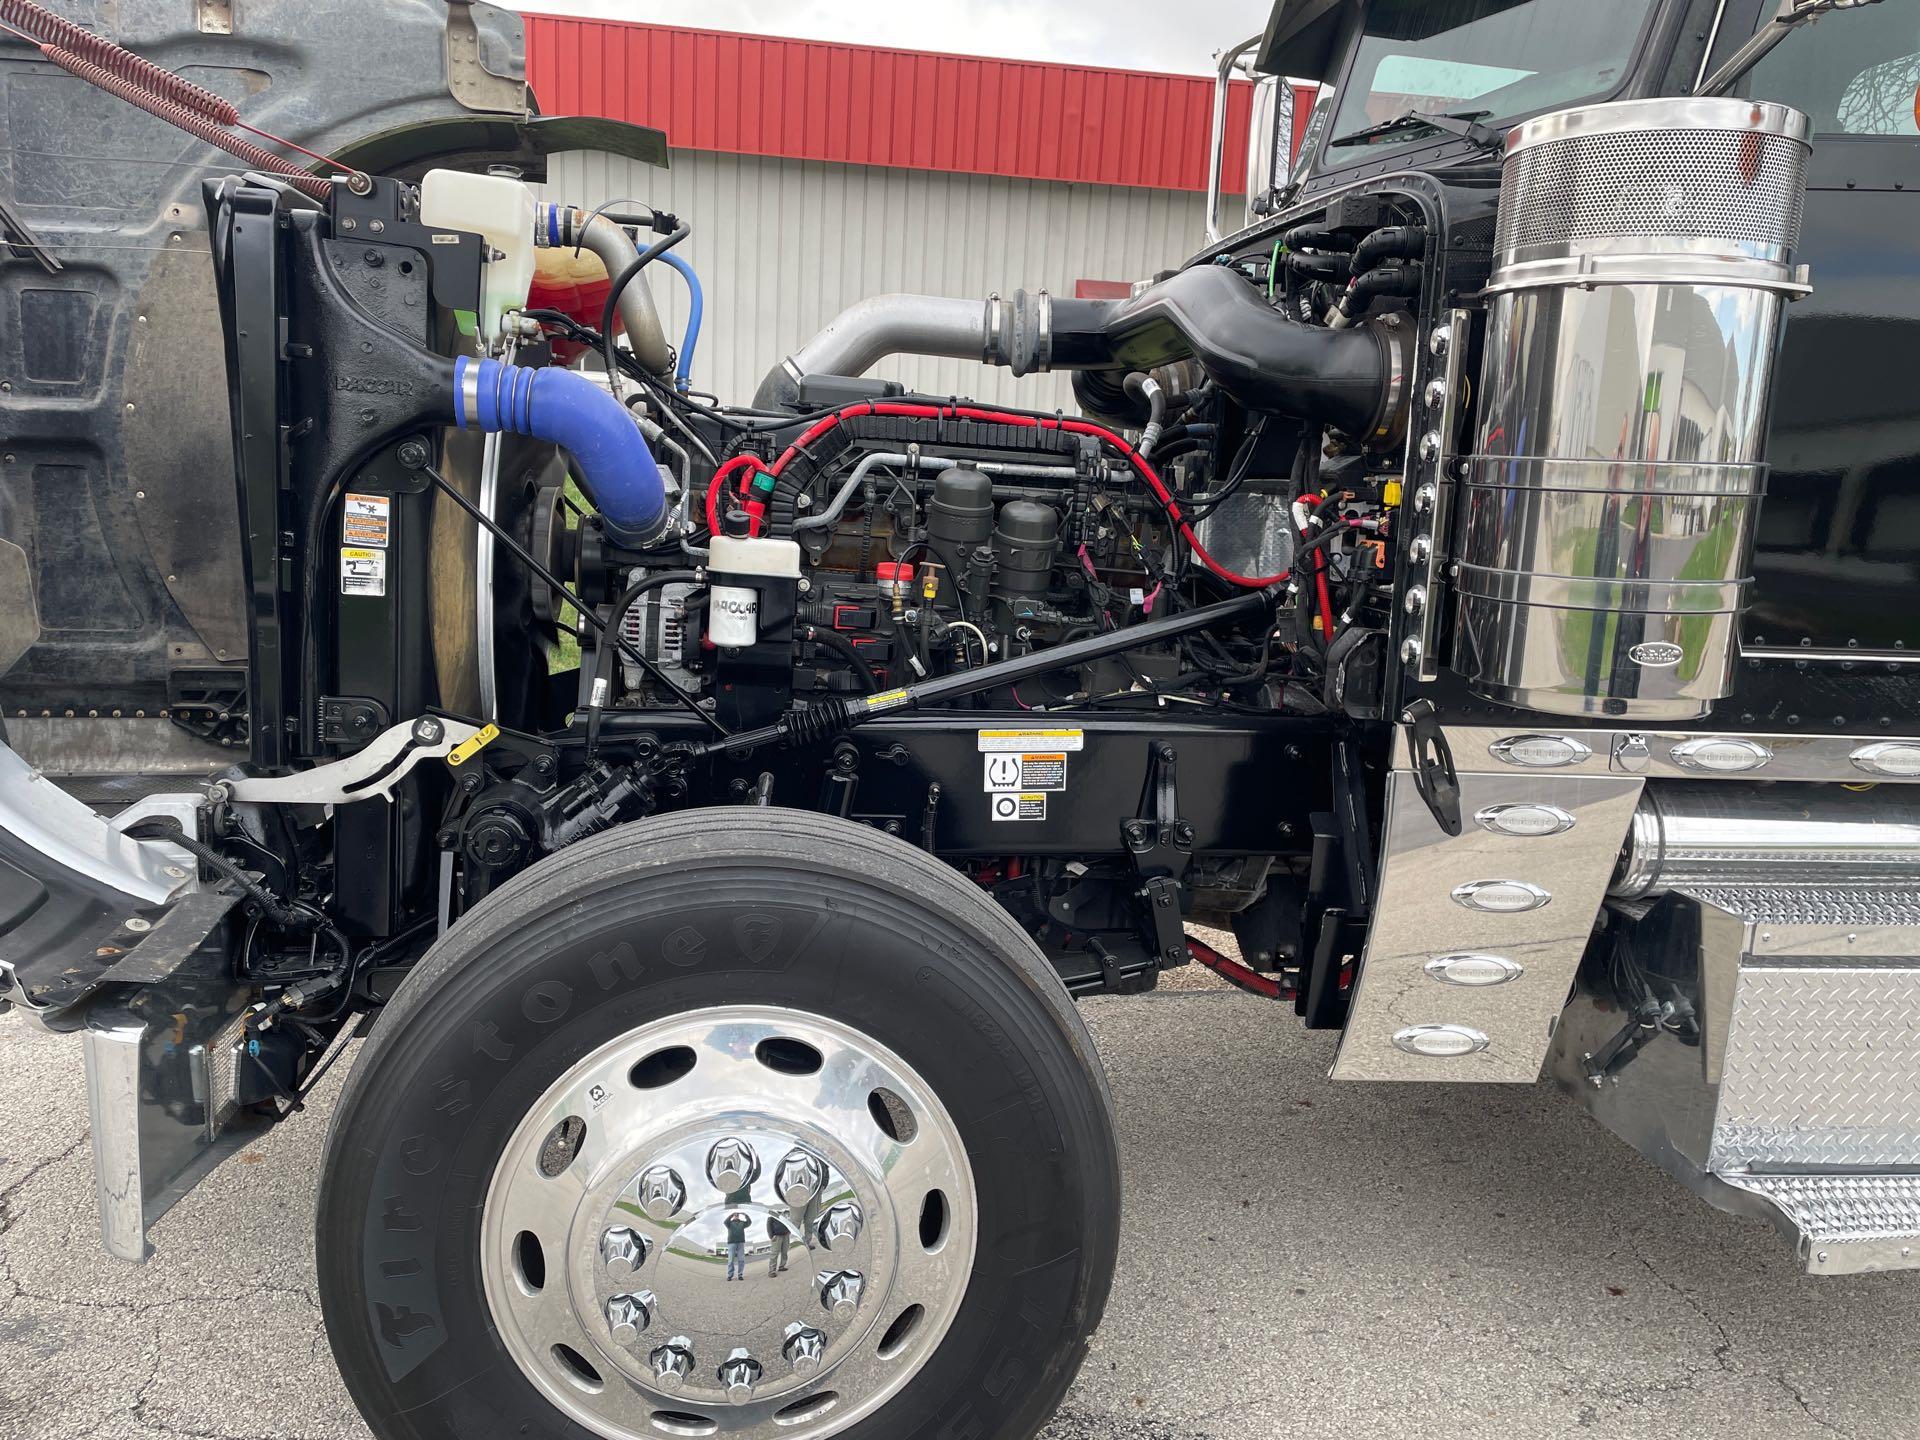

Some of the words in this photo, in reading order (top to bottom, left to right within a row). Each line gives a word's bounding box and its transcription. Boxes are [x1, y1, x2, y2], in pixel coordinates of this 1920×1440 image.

[335, 377, 413, 396] PACCAR
[592, 1092, 614, 1110] ALCOA
[374, 926, 707, 1343] Firestone
